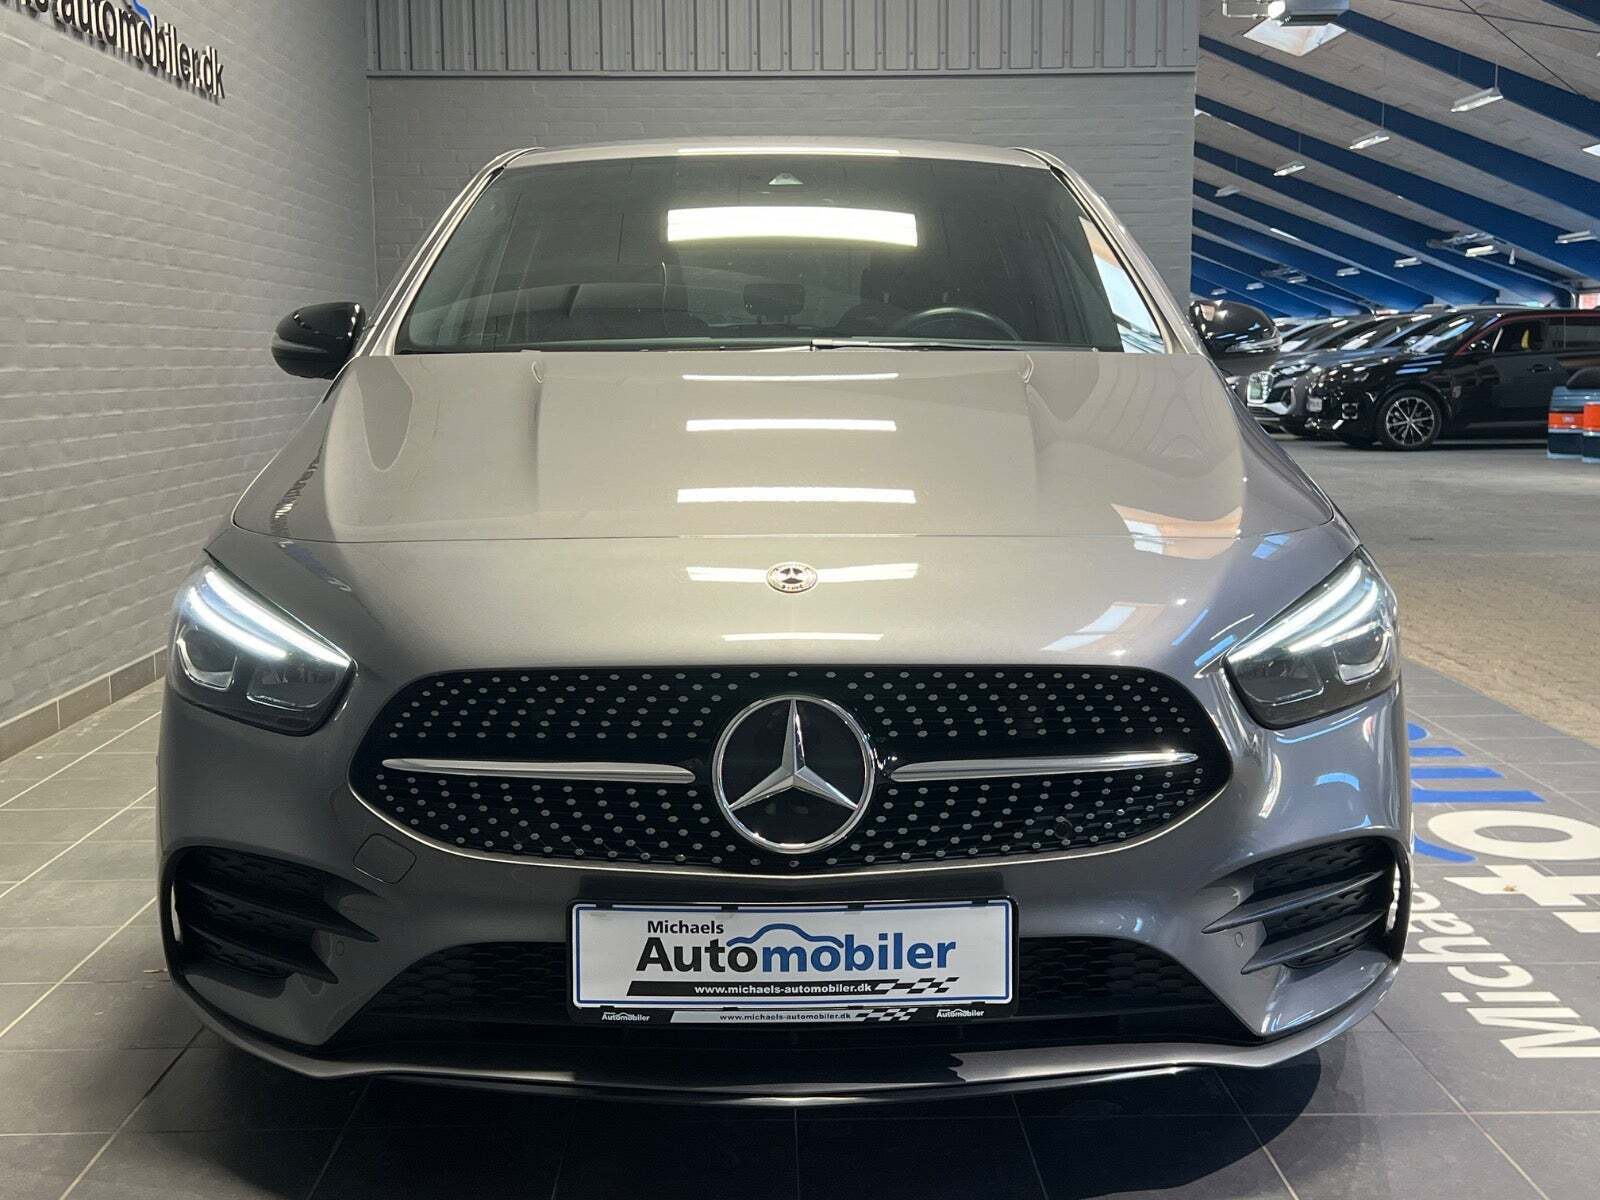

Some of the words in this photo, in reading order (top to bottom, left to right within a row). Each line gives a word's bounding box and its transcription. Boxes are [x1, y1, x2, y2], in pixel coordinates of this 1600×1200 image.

[647, 920, 724, 934] Michaels
[636, 932, 957, 973] Automobiler
[694, 983, 872, 995] www.michaels-automobiler.dk
[601, 1013, 650, 1022] Automobiler
[719, 1012, 851, 1021] www.michaels-automobiler.dk
[936, 1009, 984, 1018] Automobiler
